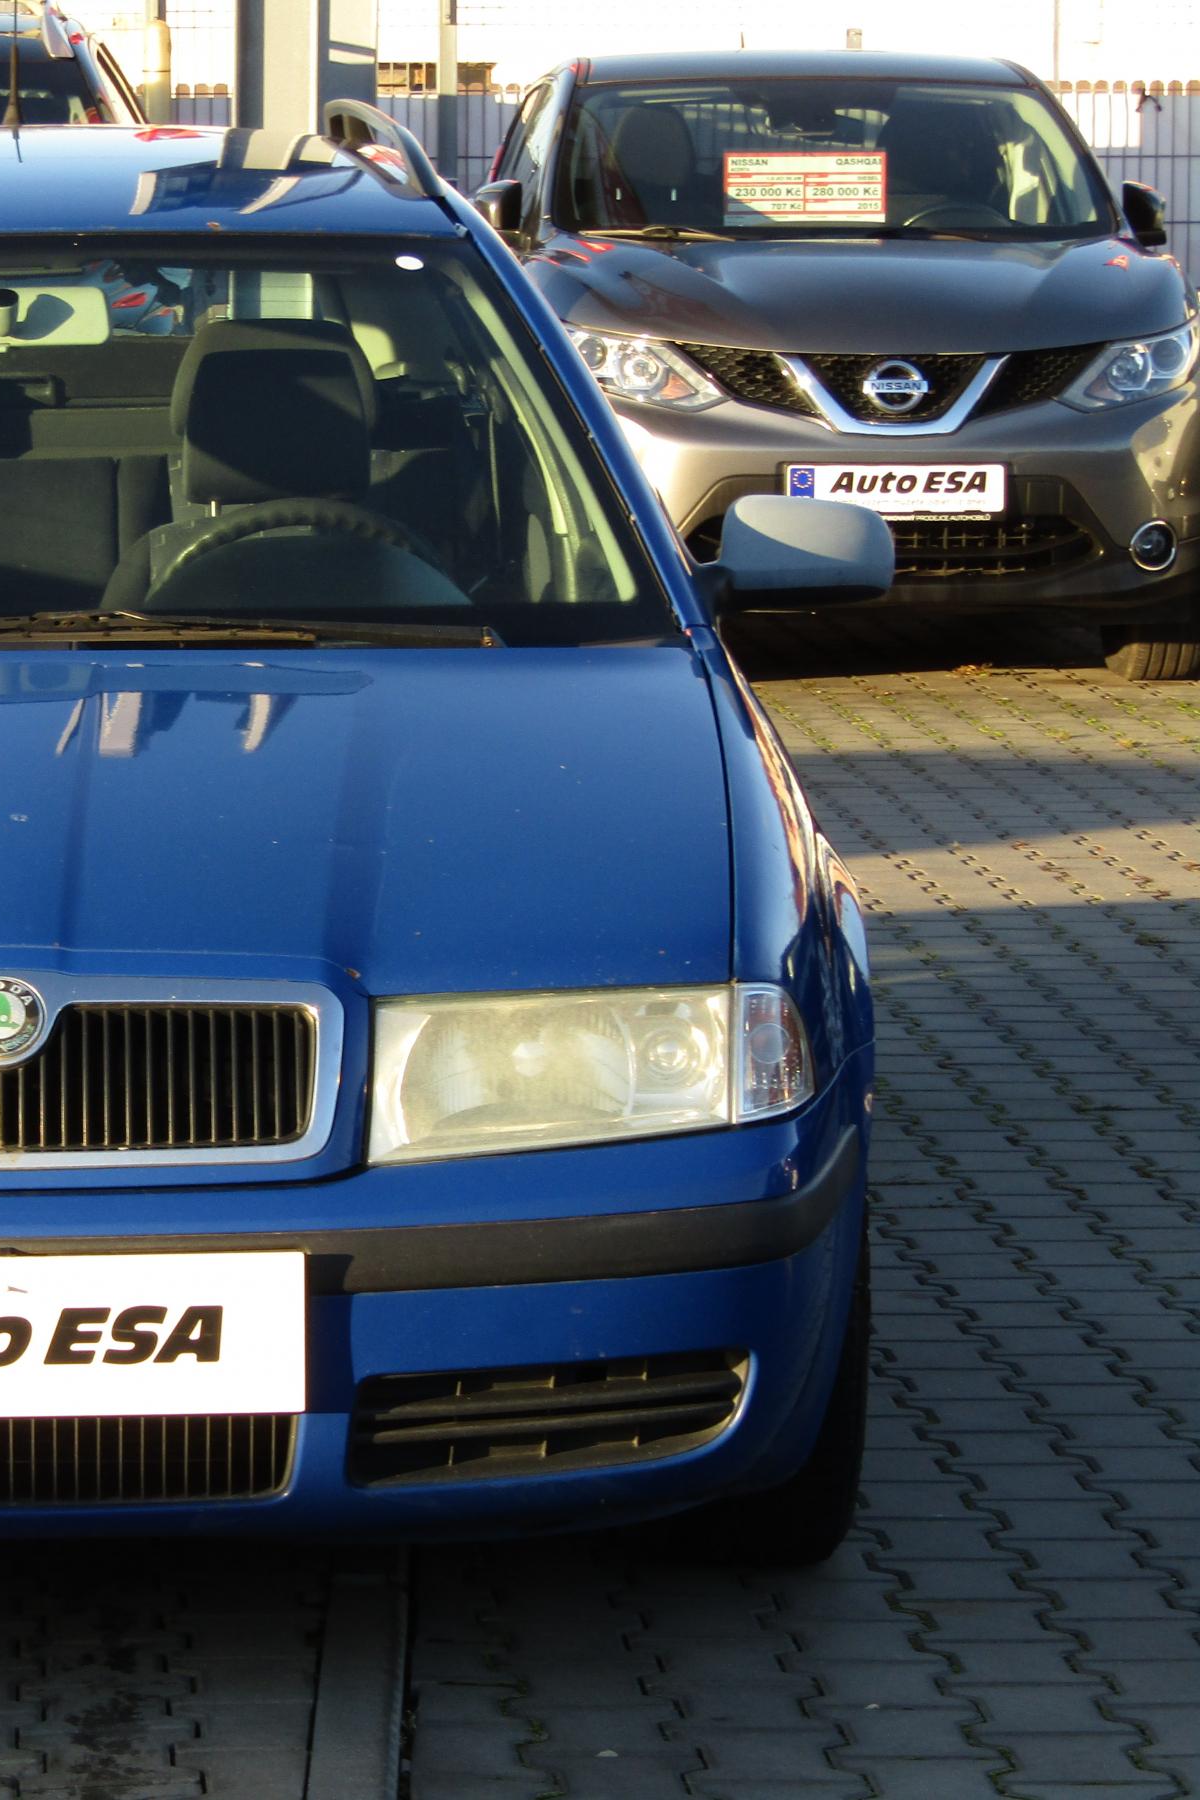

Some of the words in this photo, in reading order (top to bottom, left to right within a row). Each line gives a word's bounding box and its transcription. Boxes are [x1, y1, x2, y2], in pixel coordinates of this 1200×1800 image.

[835, 158, 882, 166] QASHQAI
[735, 188, 756, 197] 230
[760, 188, 782, 197] 000
[786, 187, 801, 197] Kč
[813, 187, 834, 196] 280
[837, 187, 859, 196] 000
[863, 187, 879, 196] Kč
[790, 202, 801, 210] Kč
[857, 202, 879, 210] 2015
[871, 381, 922, 391] NISSAN
[830, 471, 918, 493] Auto
[922, 471, 987, 493] ESA
[43, 1306, 224, 1364] ESA
